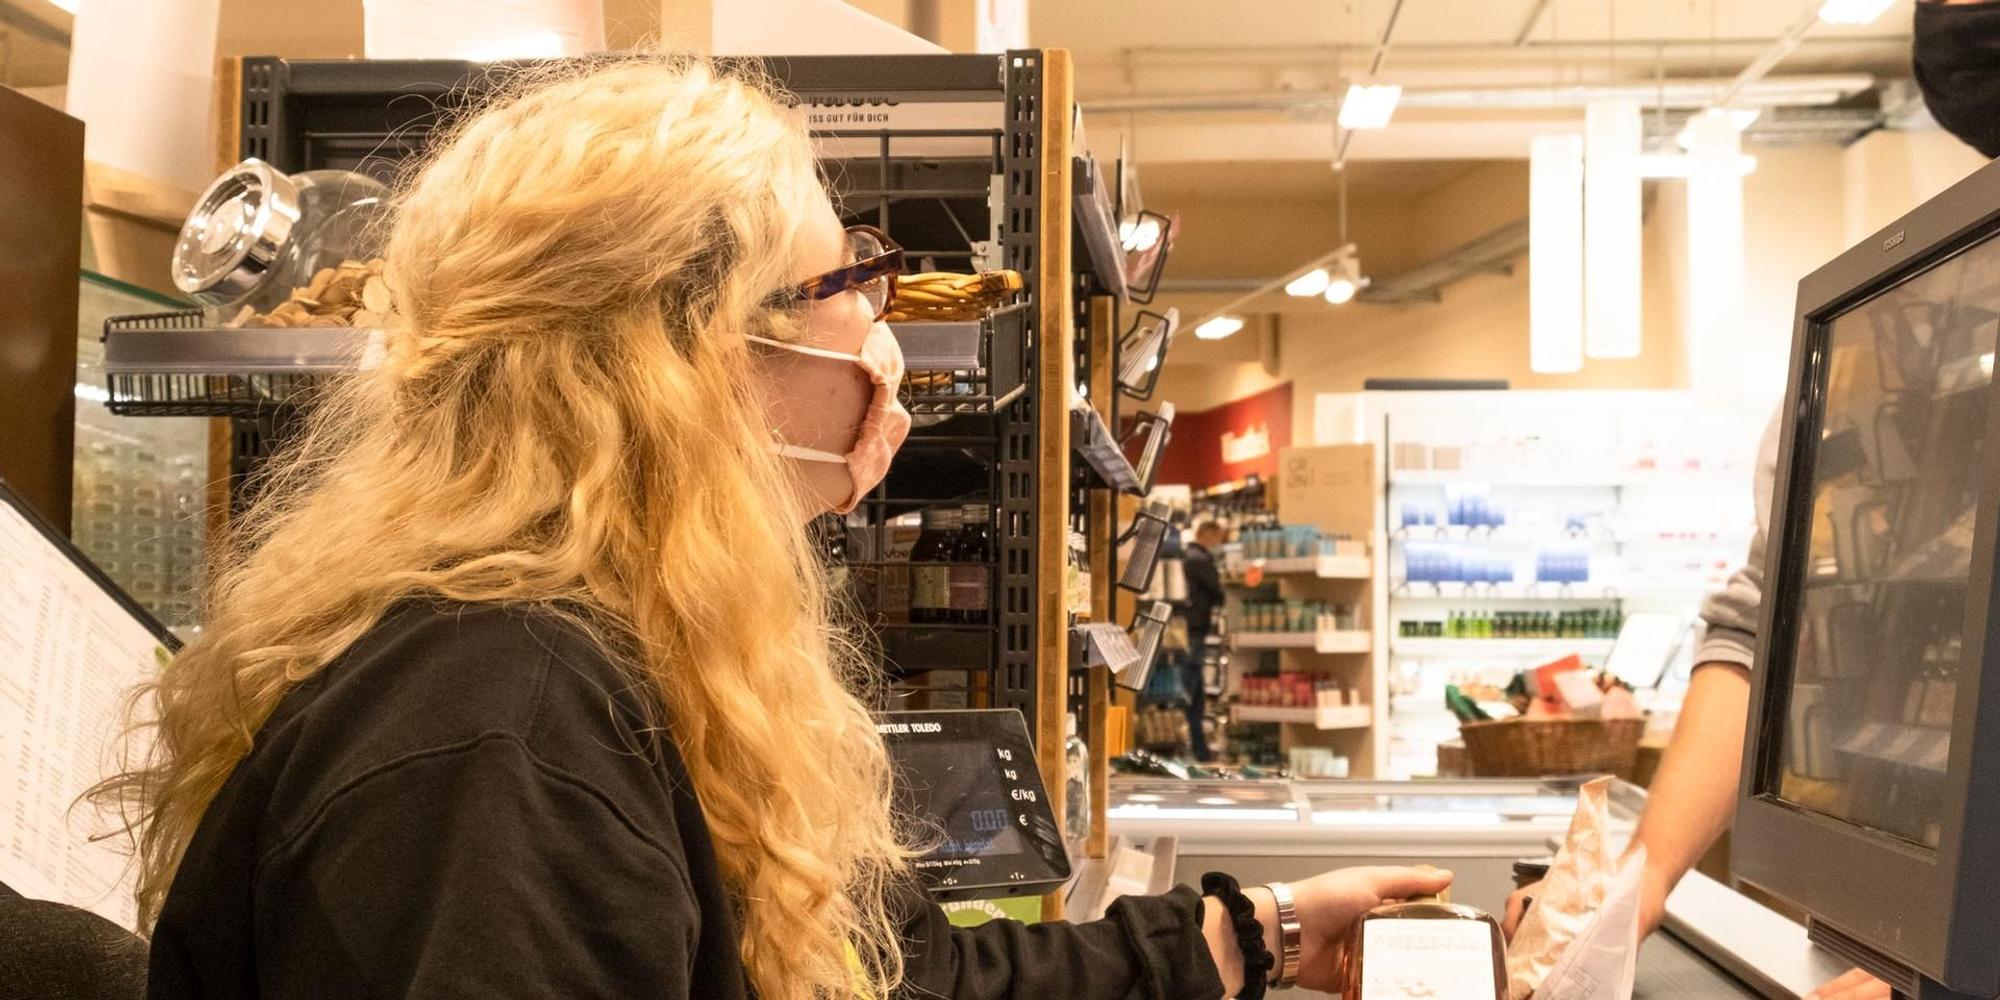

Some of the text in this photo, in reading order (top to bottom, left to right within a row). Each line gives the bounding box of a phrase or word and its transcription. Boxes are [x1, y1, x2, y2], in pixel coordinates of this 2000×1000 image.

[826, 114, 844, 123] GUT
[847, 112, 864, 123] FÜR
[867, 113, 889, 122] DICH
[911, 723, 941, 733] TOLEDO
[997, 747, 1012, 761] kg
[1004, 769, 1017, 781] kg
[1011, 789, 1036, 802] €/kg
[1019, 814, 1028, 826] €
